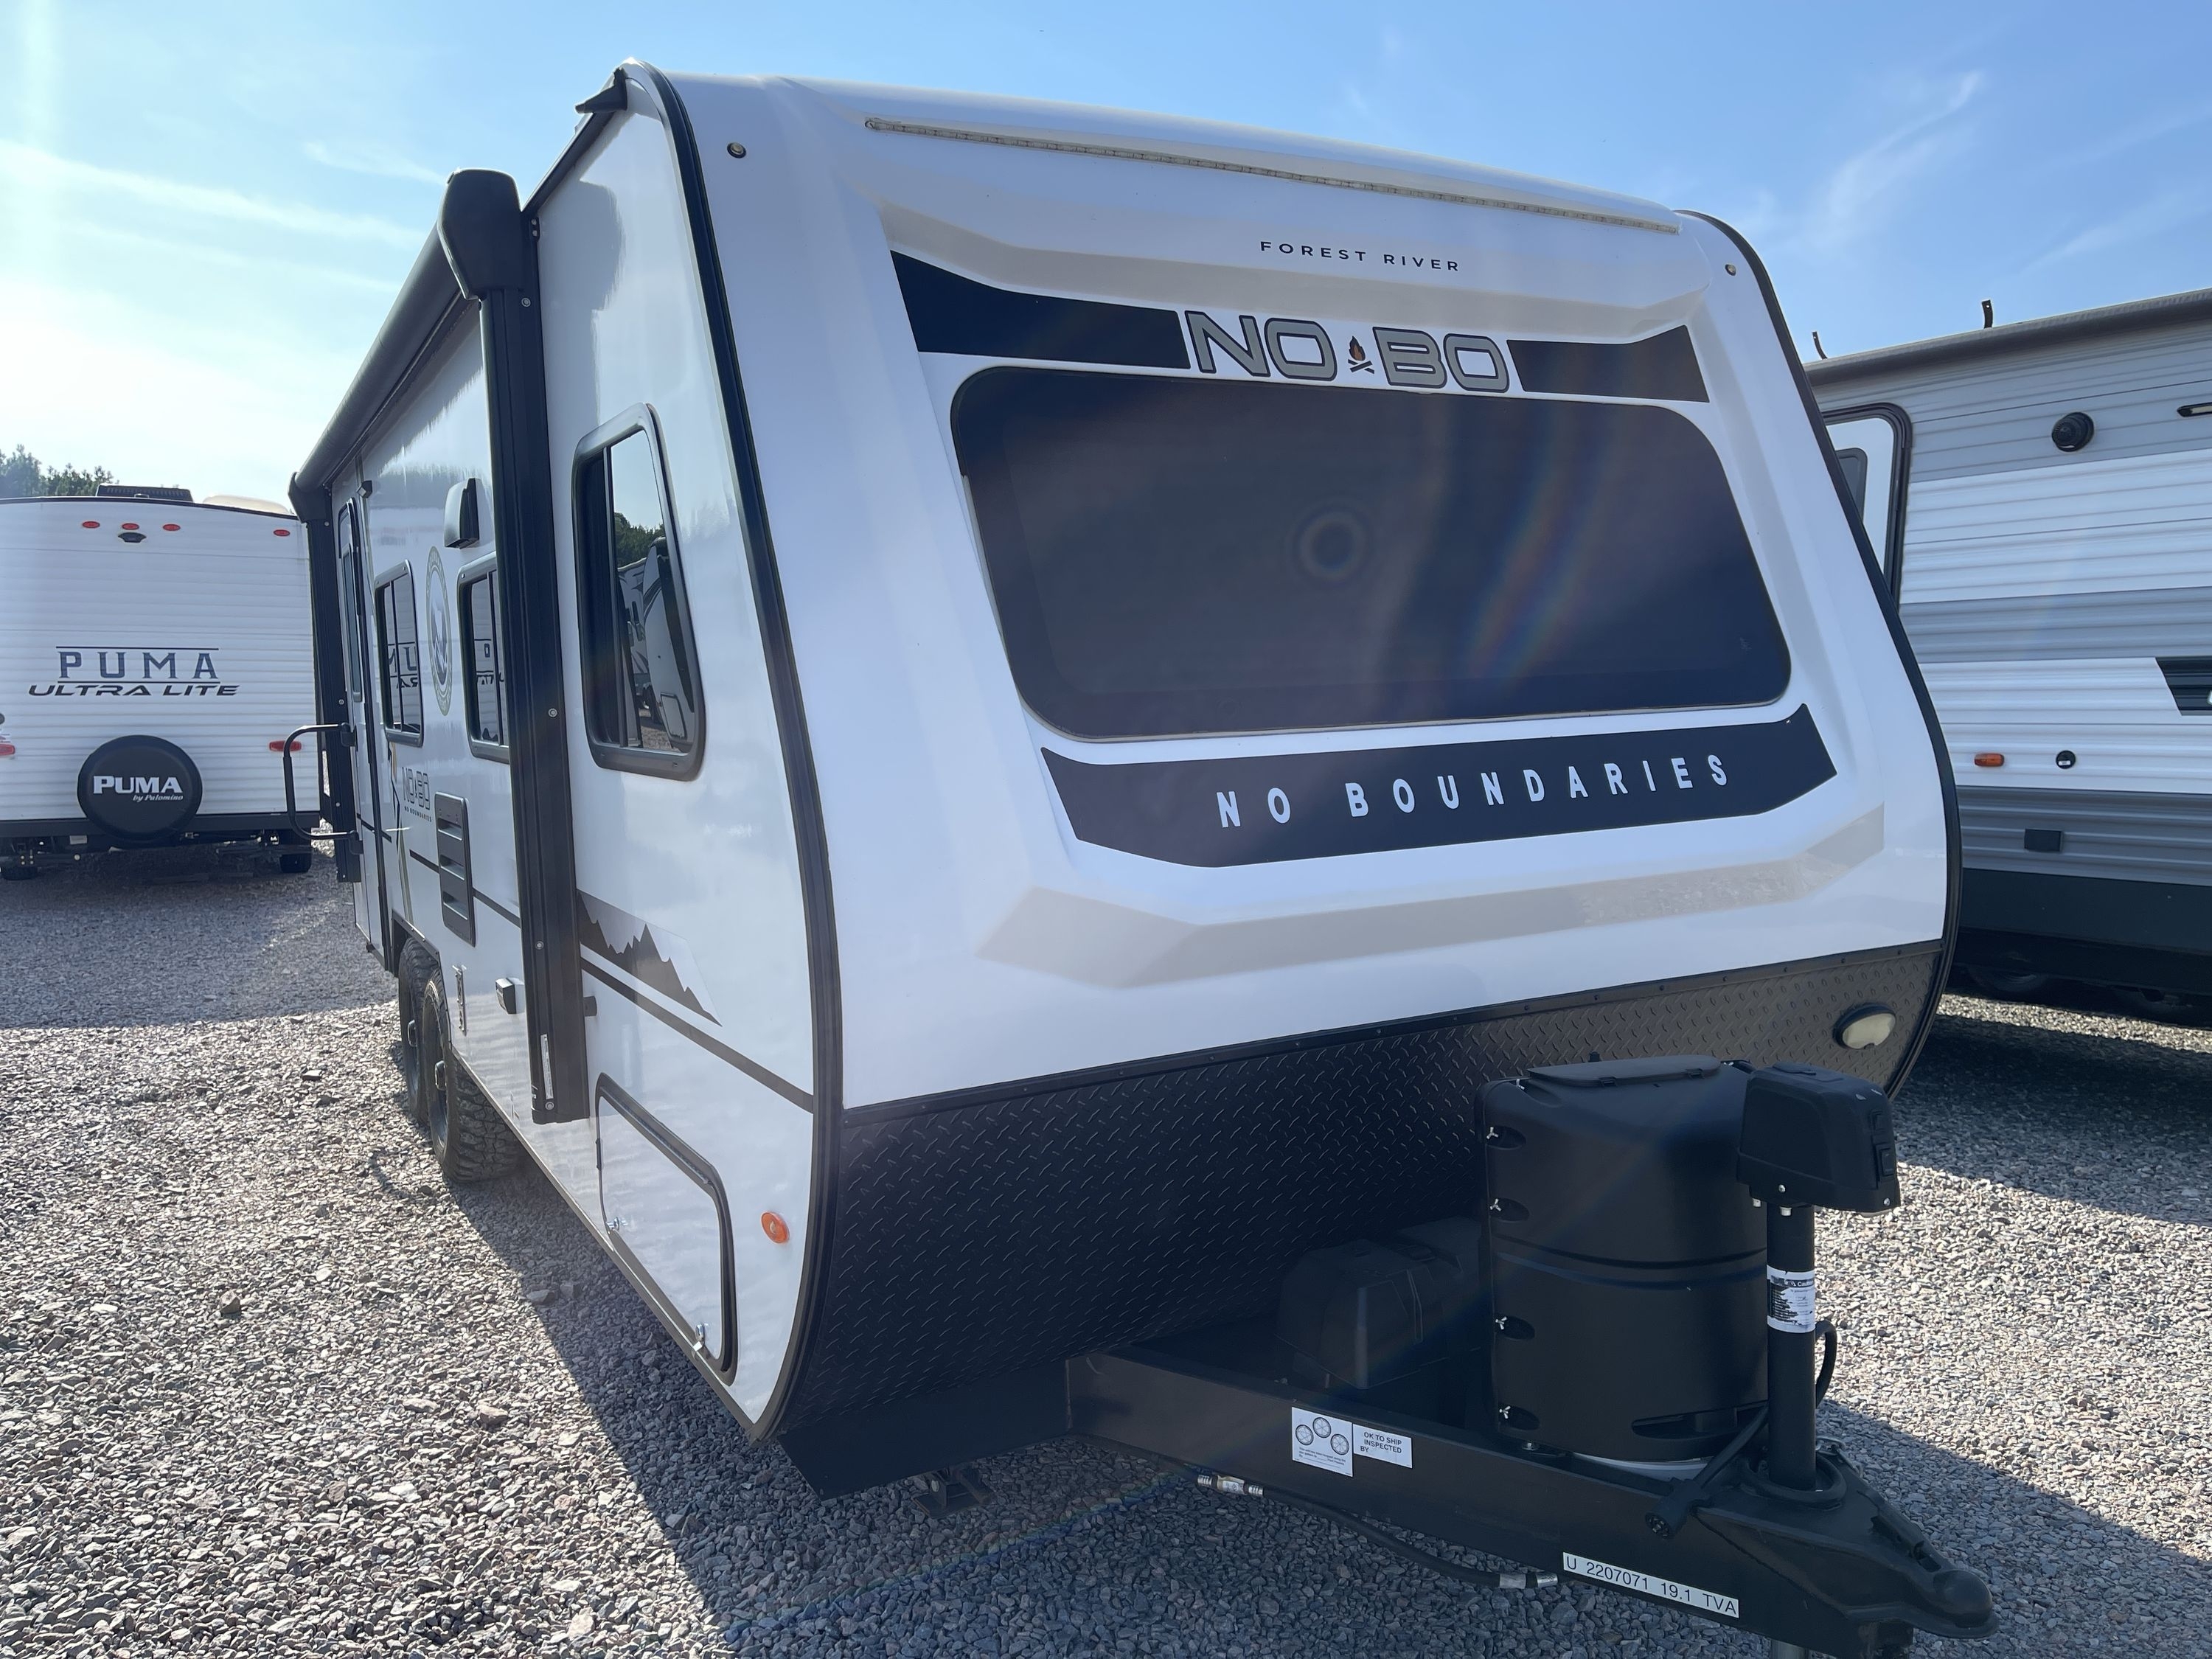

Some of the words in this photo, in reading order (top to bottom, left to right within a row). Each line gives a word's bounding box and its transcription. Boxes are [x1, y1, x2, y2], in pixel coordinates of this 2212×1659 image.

[1259, 240, 1368, 262] FOREST
[1382, 254, 1460, 272] RIVER
[1184, 310, 1338, 382] NO
[1372, 327, 1510, 393] BO
[58, 651, 219, 679] PUMA
[28, 684, 152, 697] ULTRA
[162, 684, 240, 697] LITE
[93, 775, 184, 794] PUMA
[133, 794, 144, 803] by
[1216, 787, 1292, 828] NO
[1344, 754, 1728, 818] BOUNDARIES
[1364, 1439, 1402, 1453] INSPECTED
[1566, 1556, 1577, 1571] U
[1586, 1561, 1649, 1590] 2207071
[1660, 1582, 1691, 1602] 19.1
[1702, 1593, 1737, 1615] TVA
